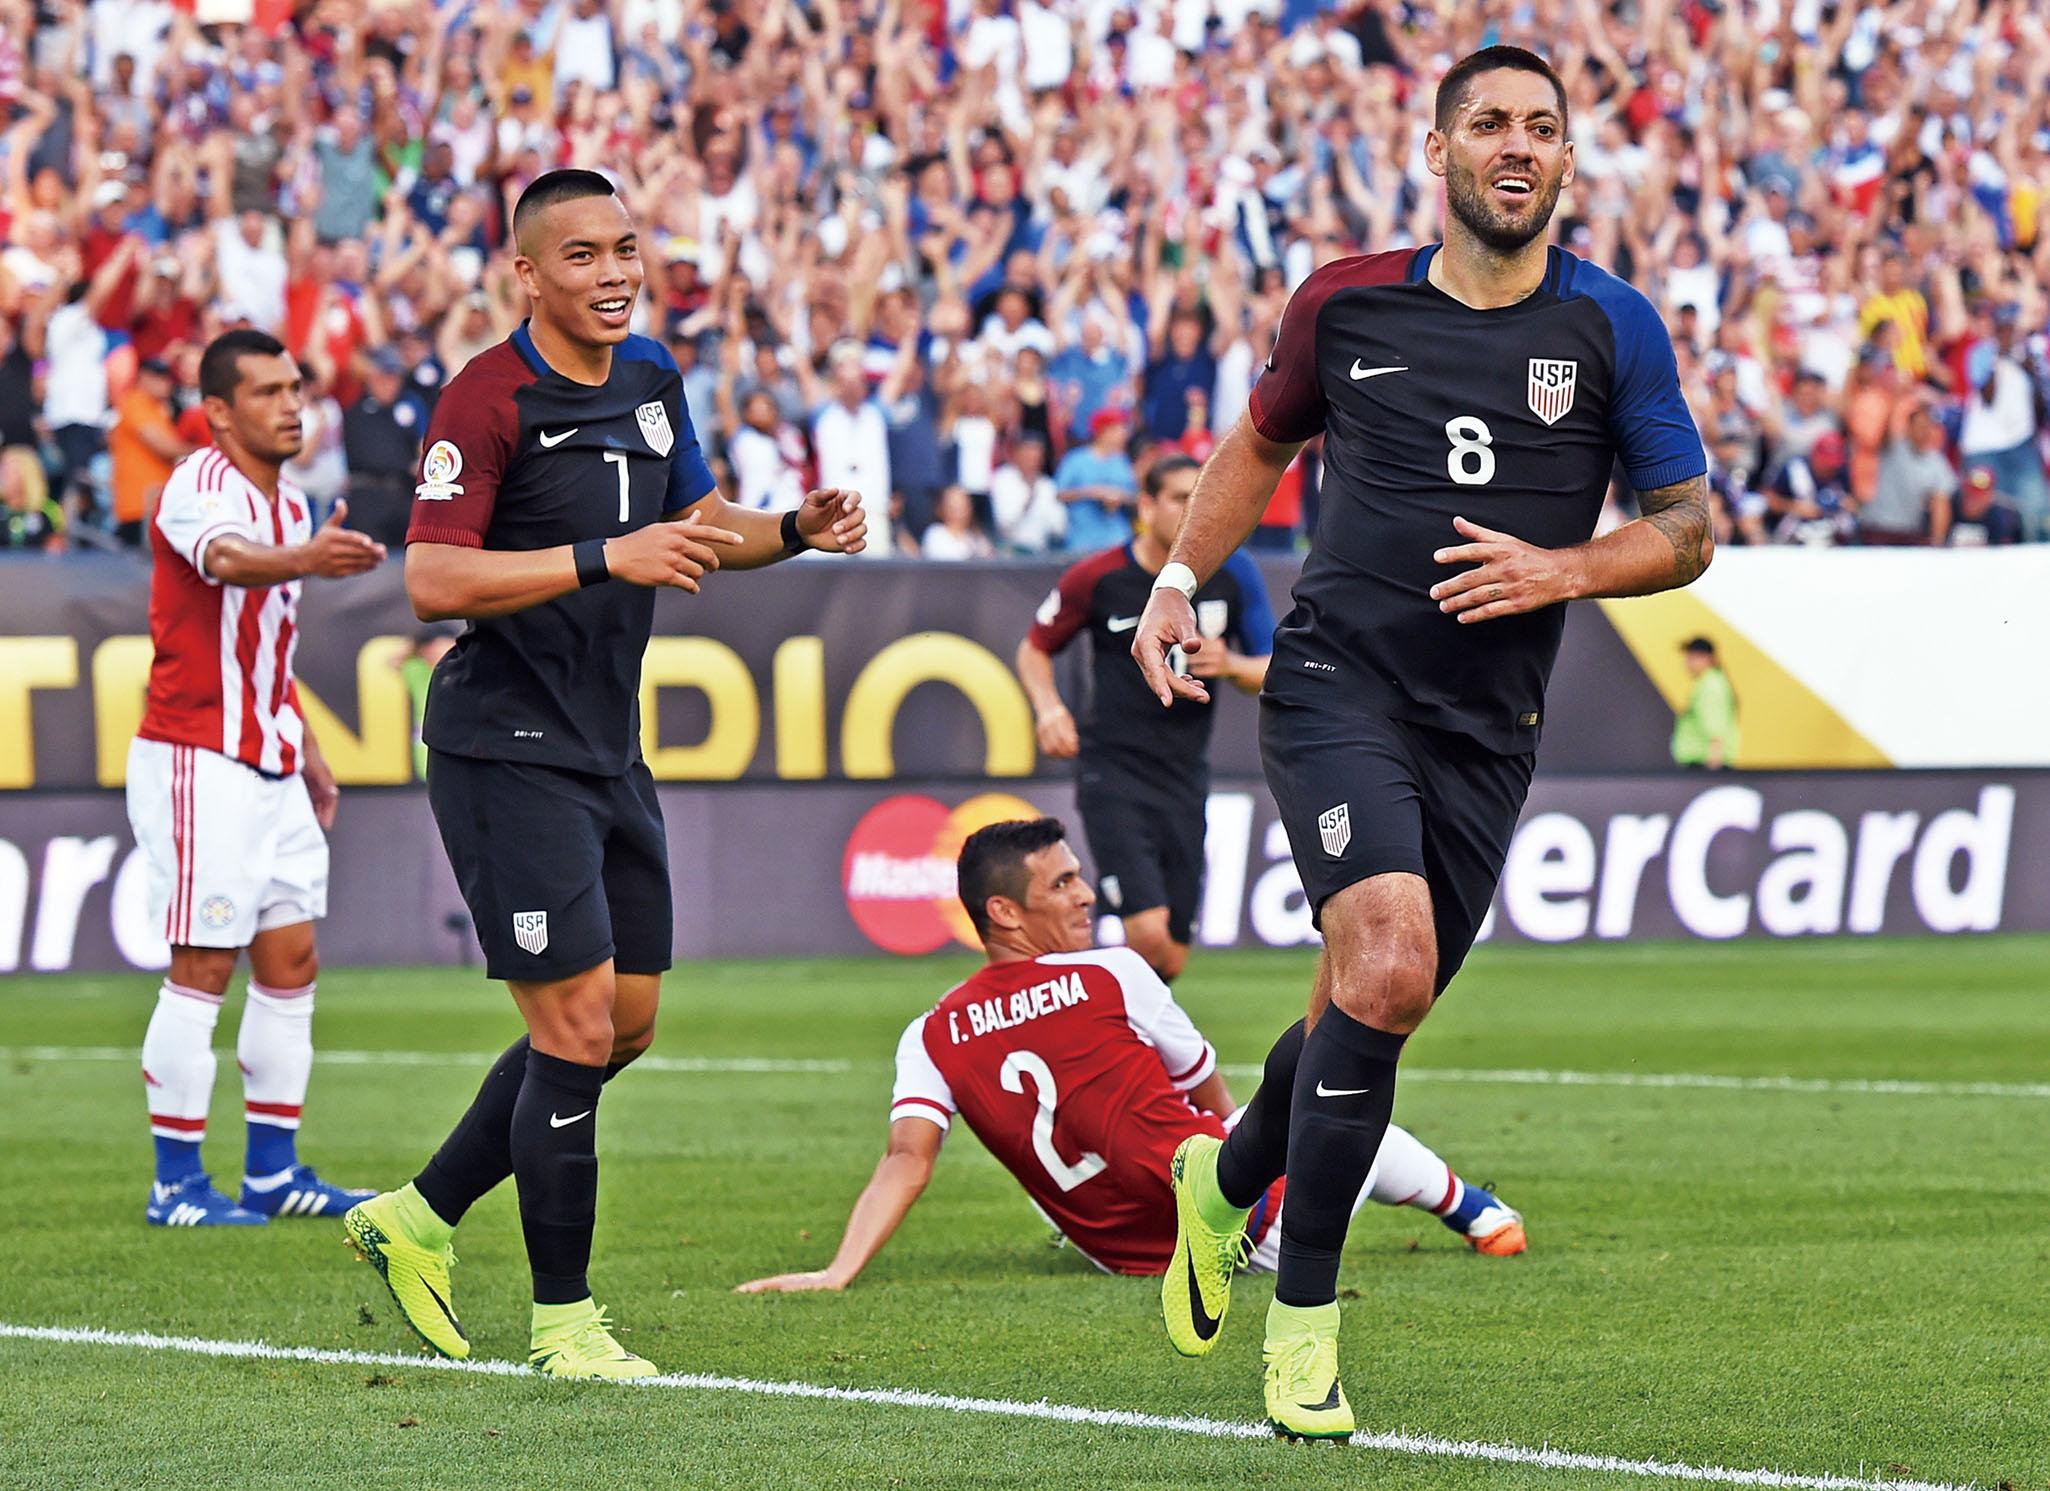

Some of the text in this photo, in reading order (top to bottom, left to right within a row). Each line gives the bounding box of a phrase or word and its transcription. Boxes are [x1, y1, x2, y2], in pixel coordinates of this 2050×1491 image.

[1533, 362, 1573, 387] USA
[639, 404, 664, 425] USA
[1445, 415, 1496, 485] 8
[1320, 807, 1345, 829] USA
[516, 914, 544, 931] USA
[966, 971, 1089, 1037] BALBUENA
[1000, 1050, 1108, 1193] 2
